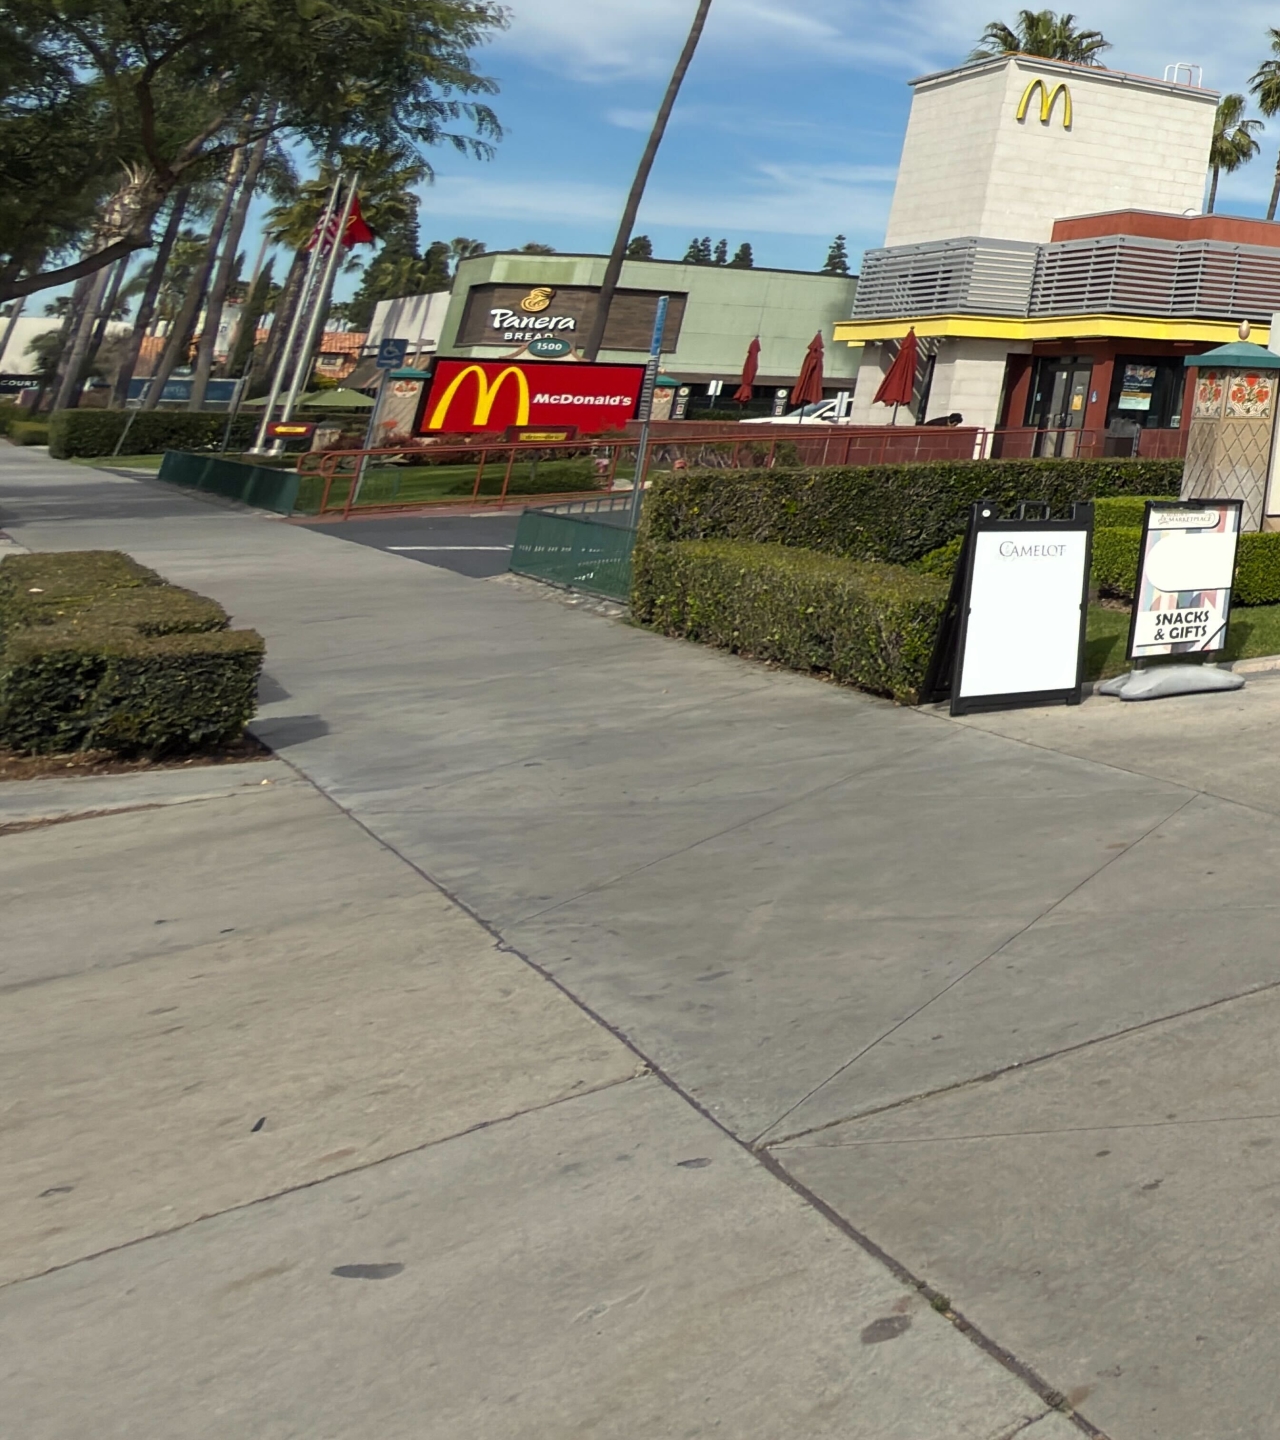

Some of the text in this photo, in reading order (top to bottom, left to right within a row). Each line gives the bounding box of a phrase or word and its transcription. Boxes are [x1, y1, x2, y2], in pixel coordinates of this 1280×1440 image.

[490, 308, 576, 330] Panera
[533, 393, 632, 407] McDonald's
[999, 540, 1067, 557] CAMELOT
[1155, 610, 1210, 626] SNACKS
[1153, 625, 1207, 640] & GIFTS
